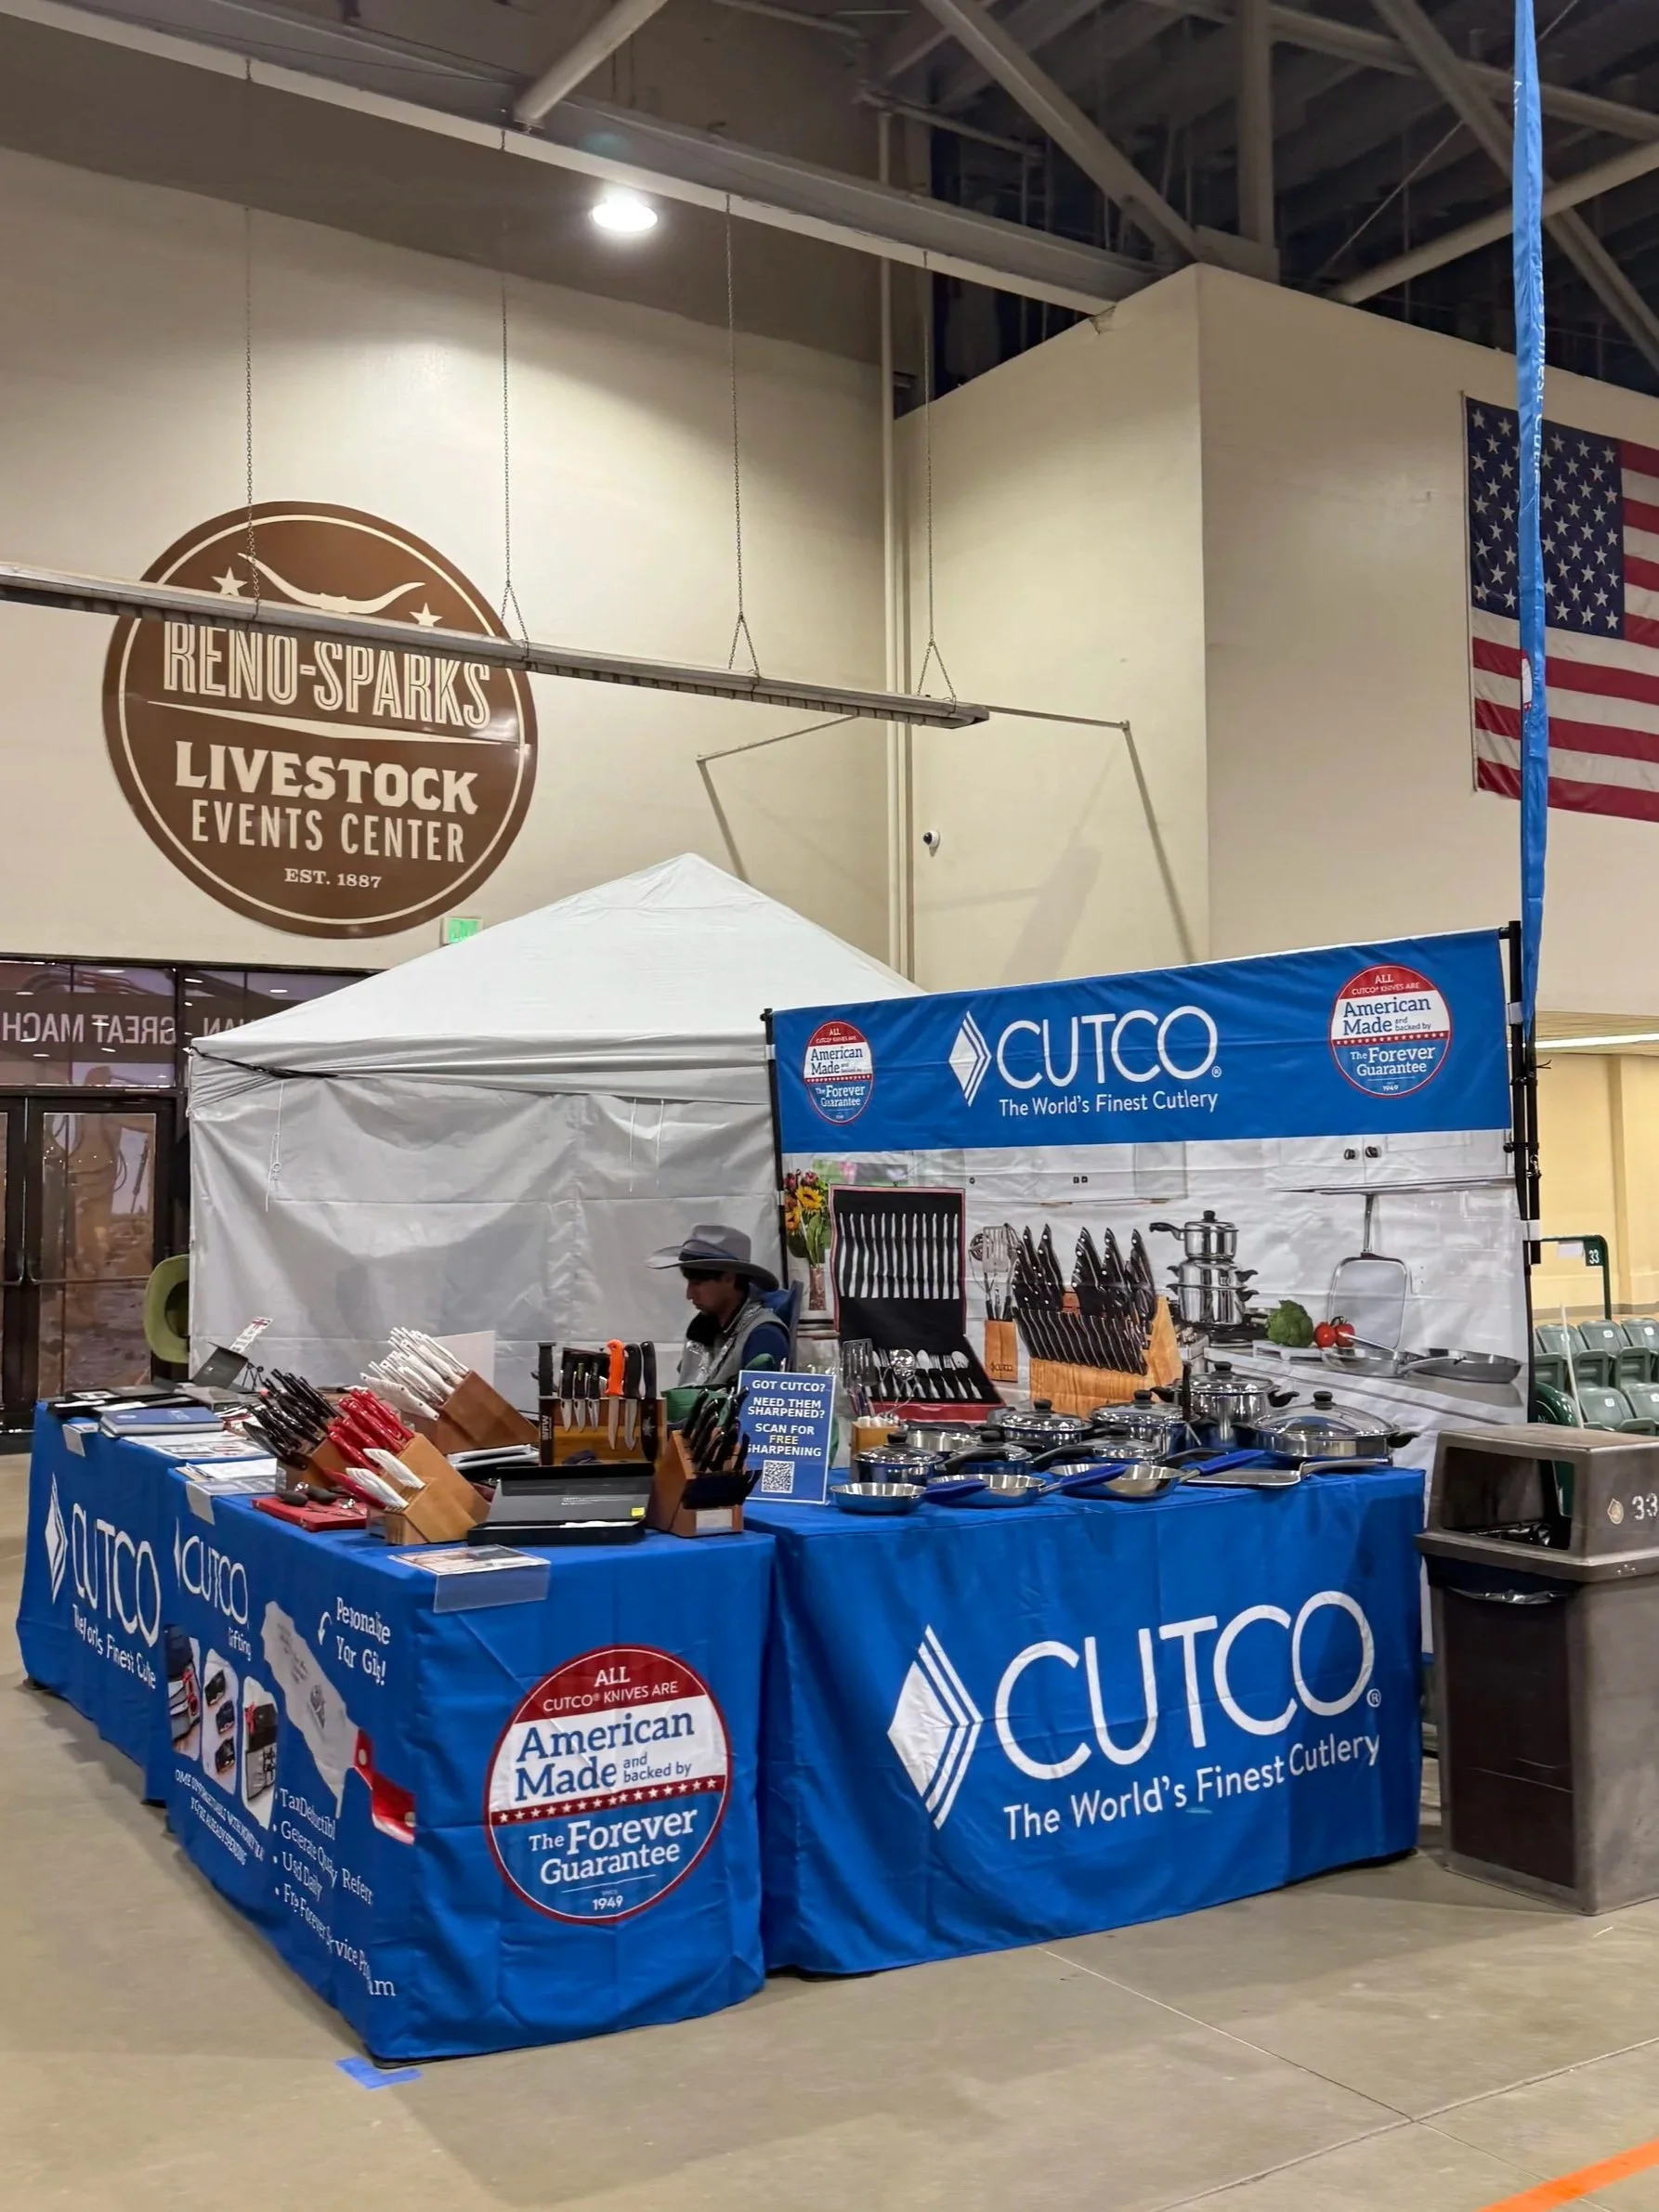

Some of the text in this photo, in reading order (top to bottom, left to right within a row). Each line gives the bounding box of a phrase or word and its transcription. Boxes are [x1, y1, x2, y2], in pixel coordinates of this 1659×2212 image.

[163, 620, 490, 729] RENO-SPARKS
[175, 740, 478, 815] LIVESTOCK
[191, 799, 464, 863] EVENTS CENTER
[284, 868, 382, 889] EST. 1887
[1375, 973, 1393, 984] ALL
[1343, 996, 1431, 1019] American
[830, 1027, 842, 1036] ALL
[1343, 1017, 1392, 1036] Made
[811, 1046, 863, 1061] American
[1350, 1046, 1436, 1063] The Forever
[811, 1060, 840, 1076] Made
[1356, 1061, 1428, 1077] Guarantee
[826, 1085, 866, 1099] Forever
[820, 1097, 861, 1108] Guarantee
[999, 1088, 1219, 1117] The World’s Finest Cutlery
[1588, 1248, 1600, 1265] 33
[751, 1379, 826, 1393] GOT CUTCO?
[747, 1406, 826, 1419] SHARPENED?
[752, 1397, 821, 1410] NEED THEM
[754, 1423, 815, 1436] SCAN FOR
[768, 1435, 799, 1445] FREE
[72, 1503, 161, 1648] CUTCO
[182, 1535, 248, 1625] CUTCO
[594, 1667, 631, 1686] ALL
[604, 1685, 648, 1703] KNIVES
[652, 1681, 678, 1696] ARE
[516, 1711, 695, 1763] American
[515, 1751, 647, 1802] Made and
[623, 1762, 692, 1783] backed by
[1003, 1733, 1380, 1841] The World’s Finest Cutlery
[529, 1809, 698, 1855] The Forever
[540, 1842, 680, 1885] Guarantee
[592, 1895, 623, 1911] 1949
